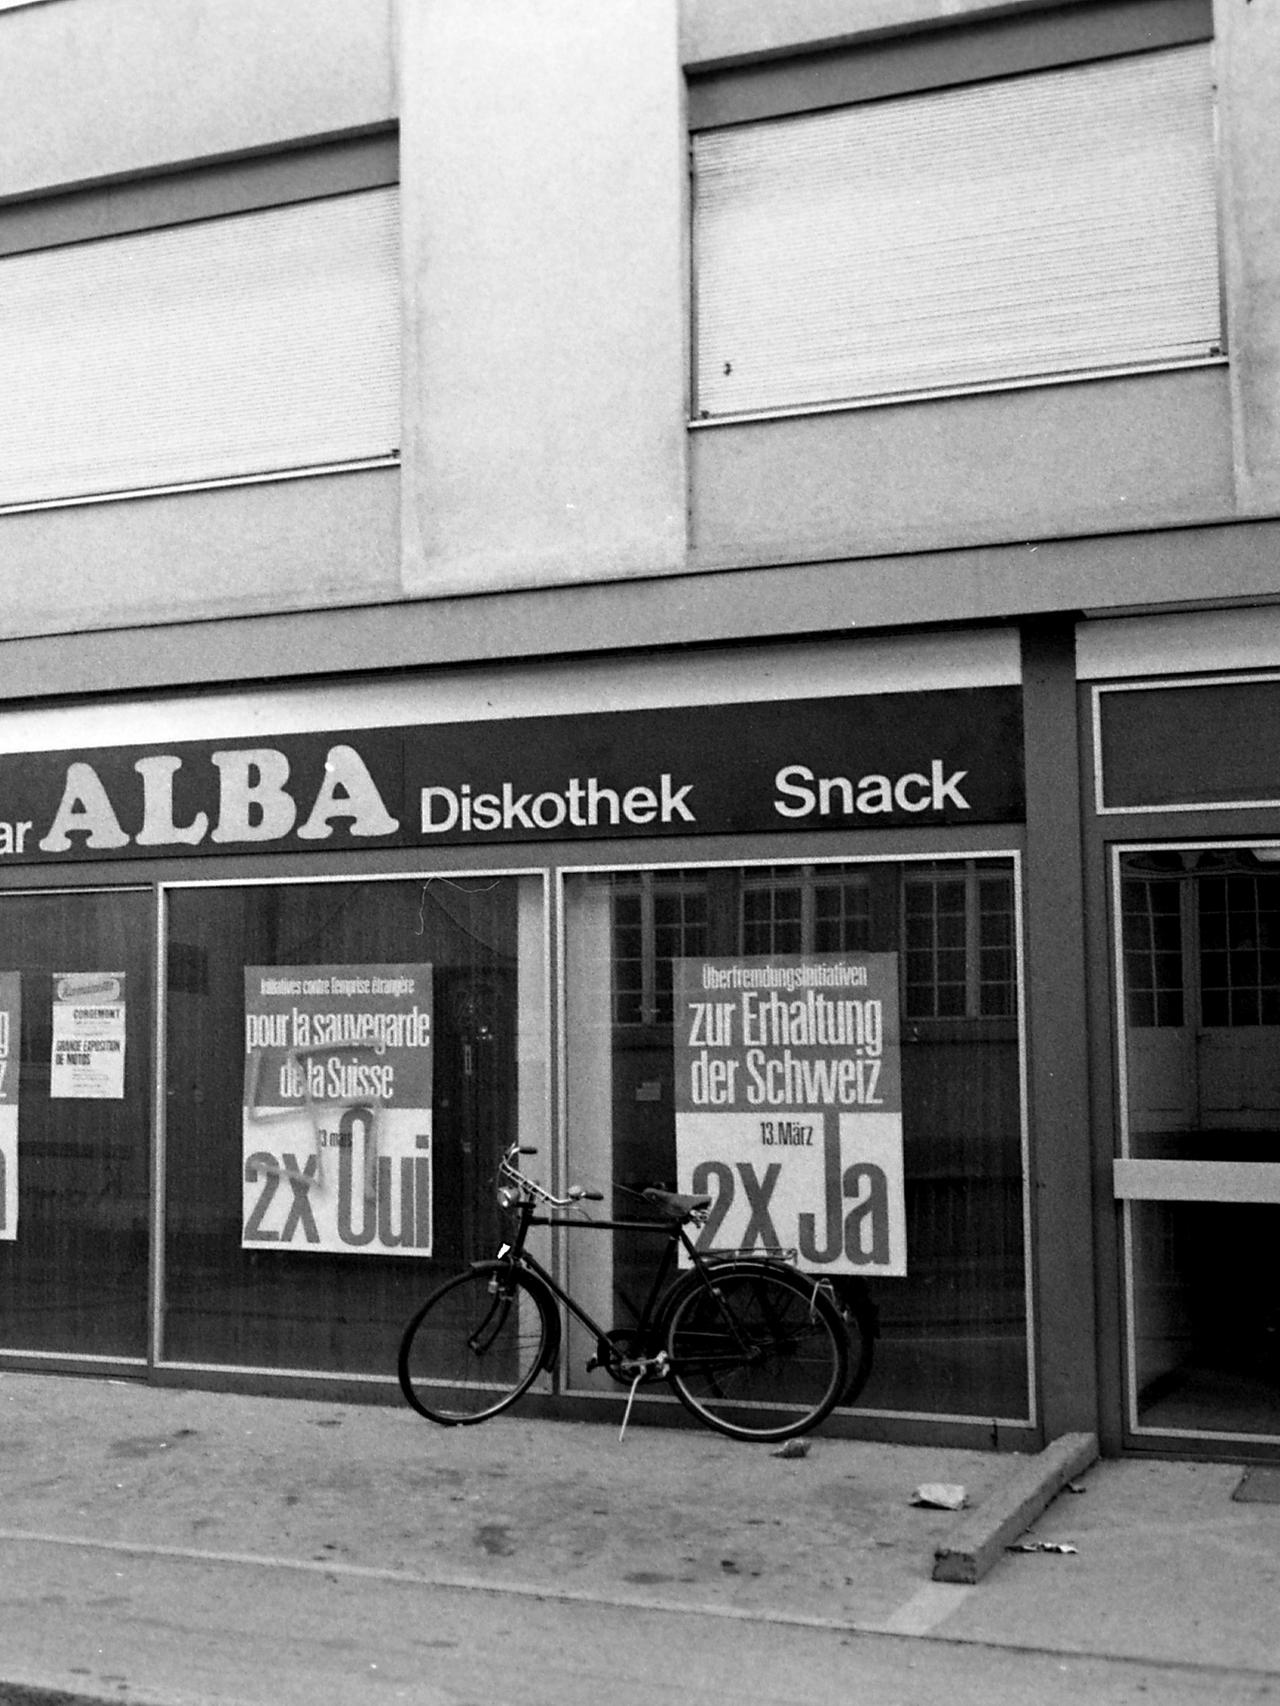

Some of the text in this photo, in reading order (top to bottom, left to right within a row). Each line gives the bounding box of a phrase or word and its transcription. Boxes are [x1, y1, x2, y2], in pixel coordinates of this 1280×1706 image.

[38, 744, 400, 853] ALBA
[420, 773, 696, 834] Diskothek
[772, 760, 971, 819] Snack
[246, 1005, 430, 1055] pour la sauvegarde
[688, 989, 883, 1056] zur Erhaltung
[280, 1056, 394, 1099] de la Suisse
[690, 1047, 884, 1105] der Schweiz
[337, 1107, 430, 1248] Oui
[798, 1112, 890, 1266] Ja
